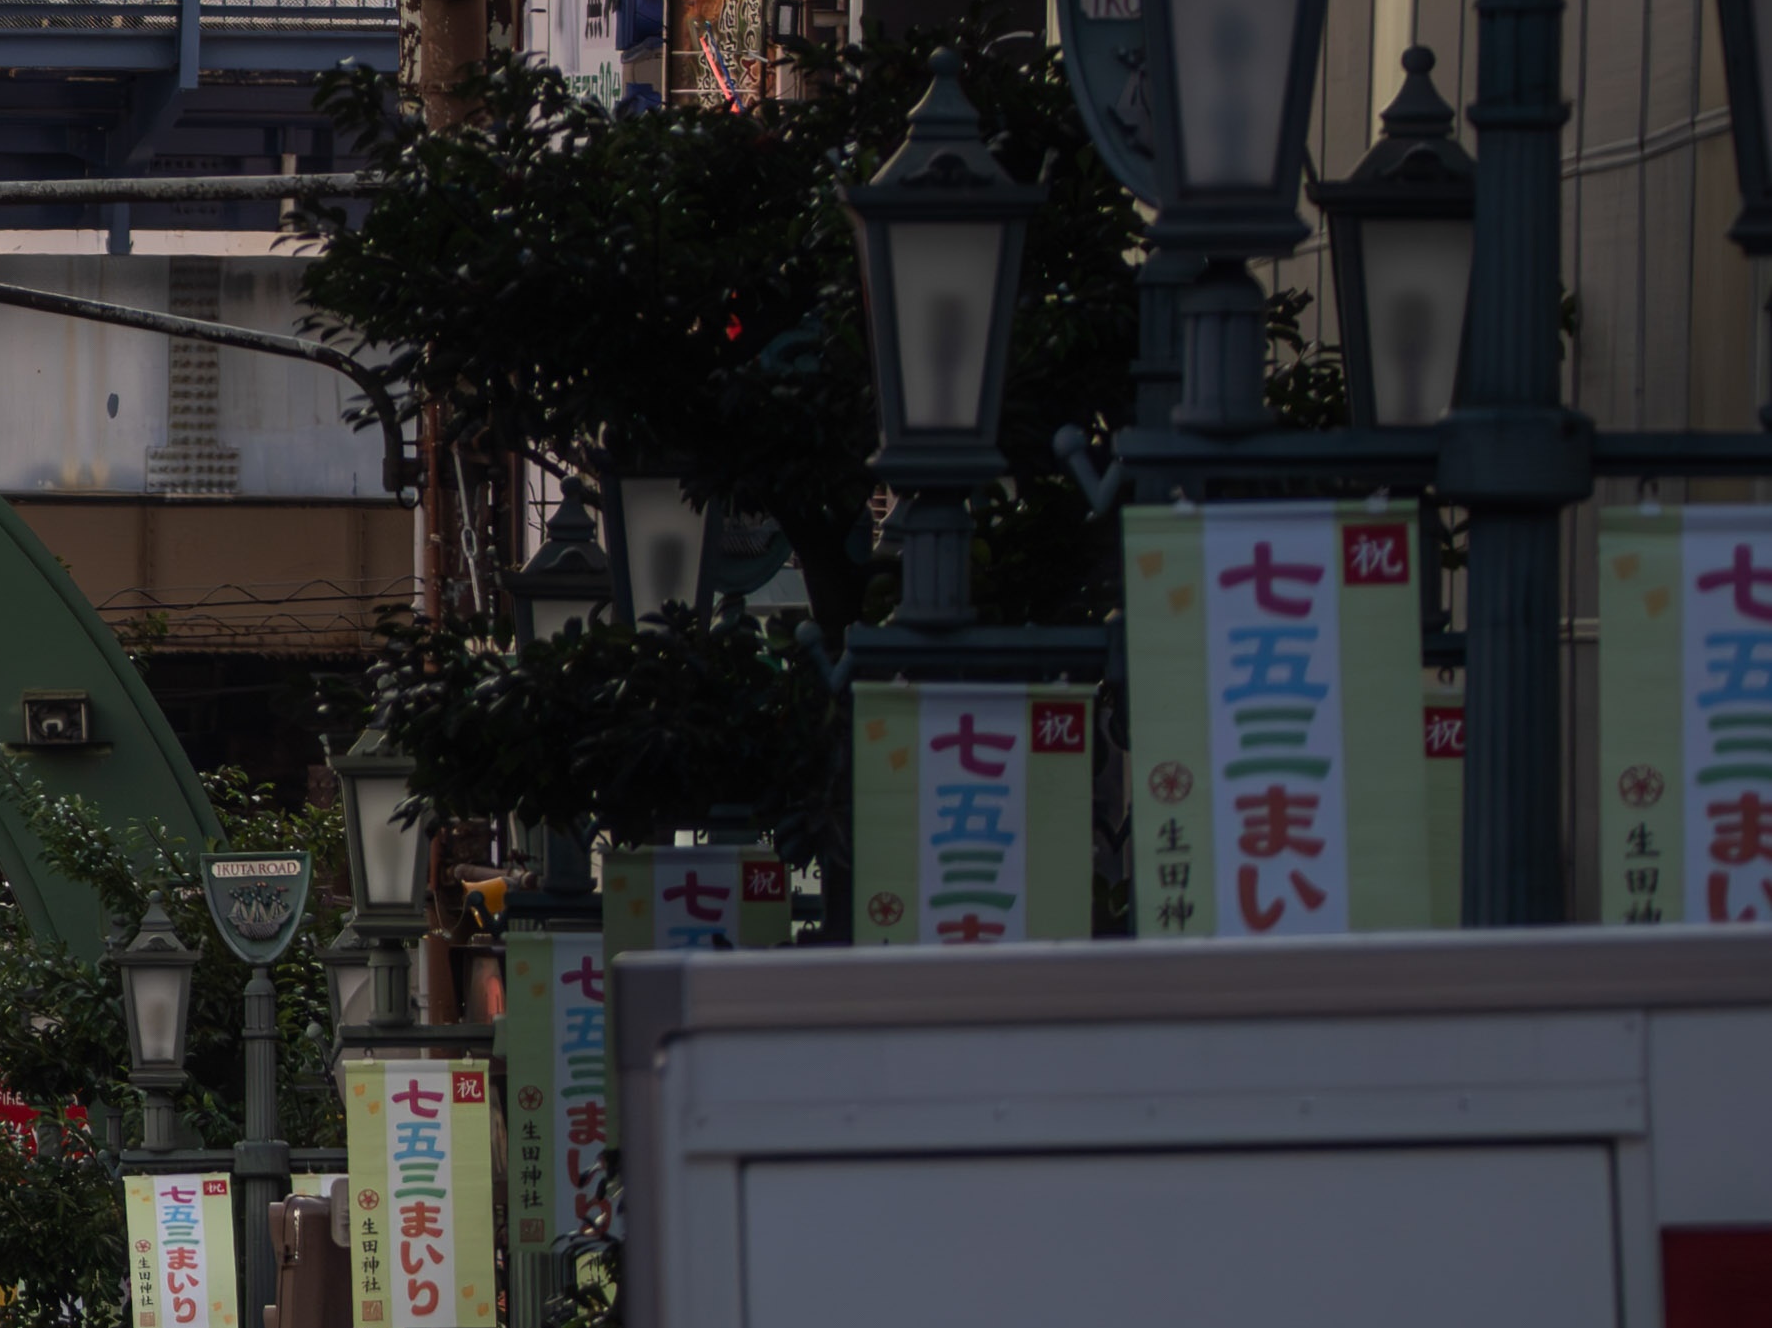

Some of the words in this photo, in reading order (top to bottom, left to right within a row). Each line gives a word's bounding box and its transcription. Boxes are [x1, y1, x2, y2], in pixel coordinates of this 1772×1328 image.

[217, 861, 256, 876] IKUTA
[258, 861, 298, 876] ROAD
[456, 1073, 485, 1102] 祝
[391, 1078, 447, 1317] 七五三まいり
[520, 1120, 543, 1210] 生田神社
[160, 1185, 198, 1324] 七五三まいり
[359, 1217, 382, 1294] 生田神社
